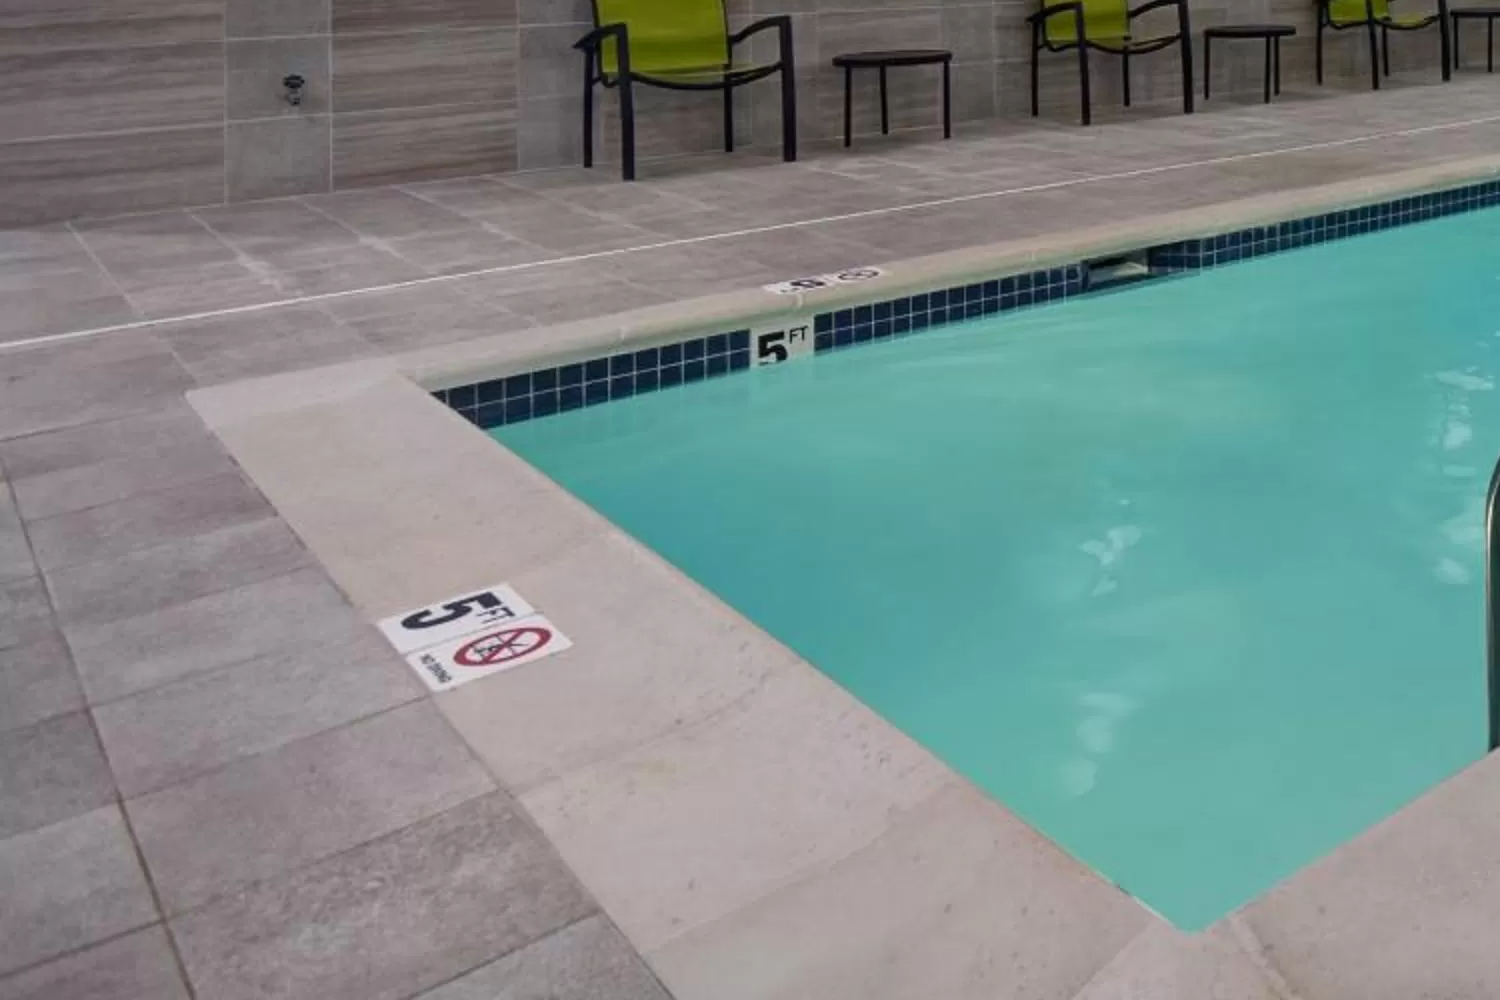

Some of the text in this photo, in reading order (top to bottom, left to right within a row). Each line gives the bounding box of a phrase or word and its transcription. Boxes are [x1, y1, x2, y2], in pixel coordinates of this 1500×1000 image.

[757, 325, 809, 366] 5 FT
[401, 591, 503, 630] 5
